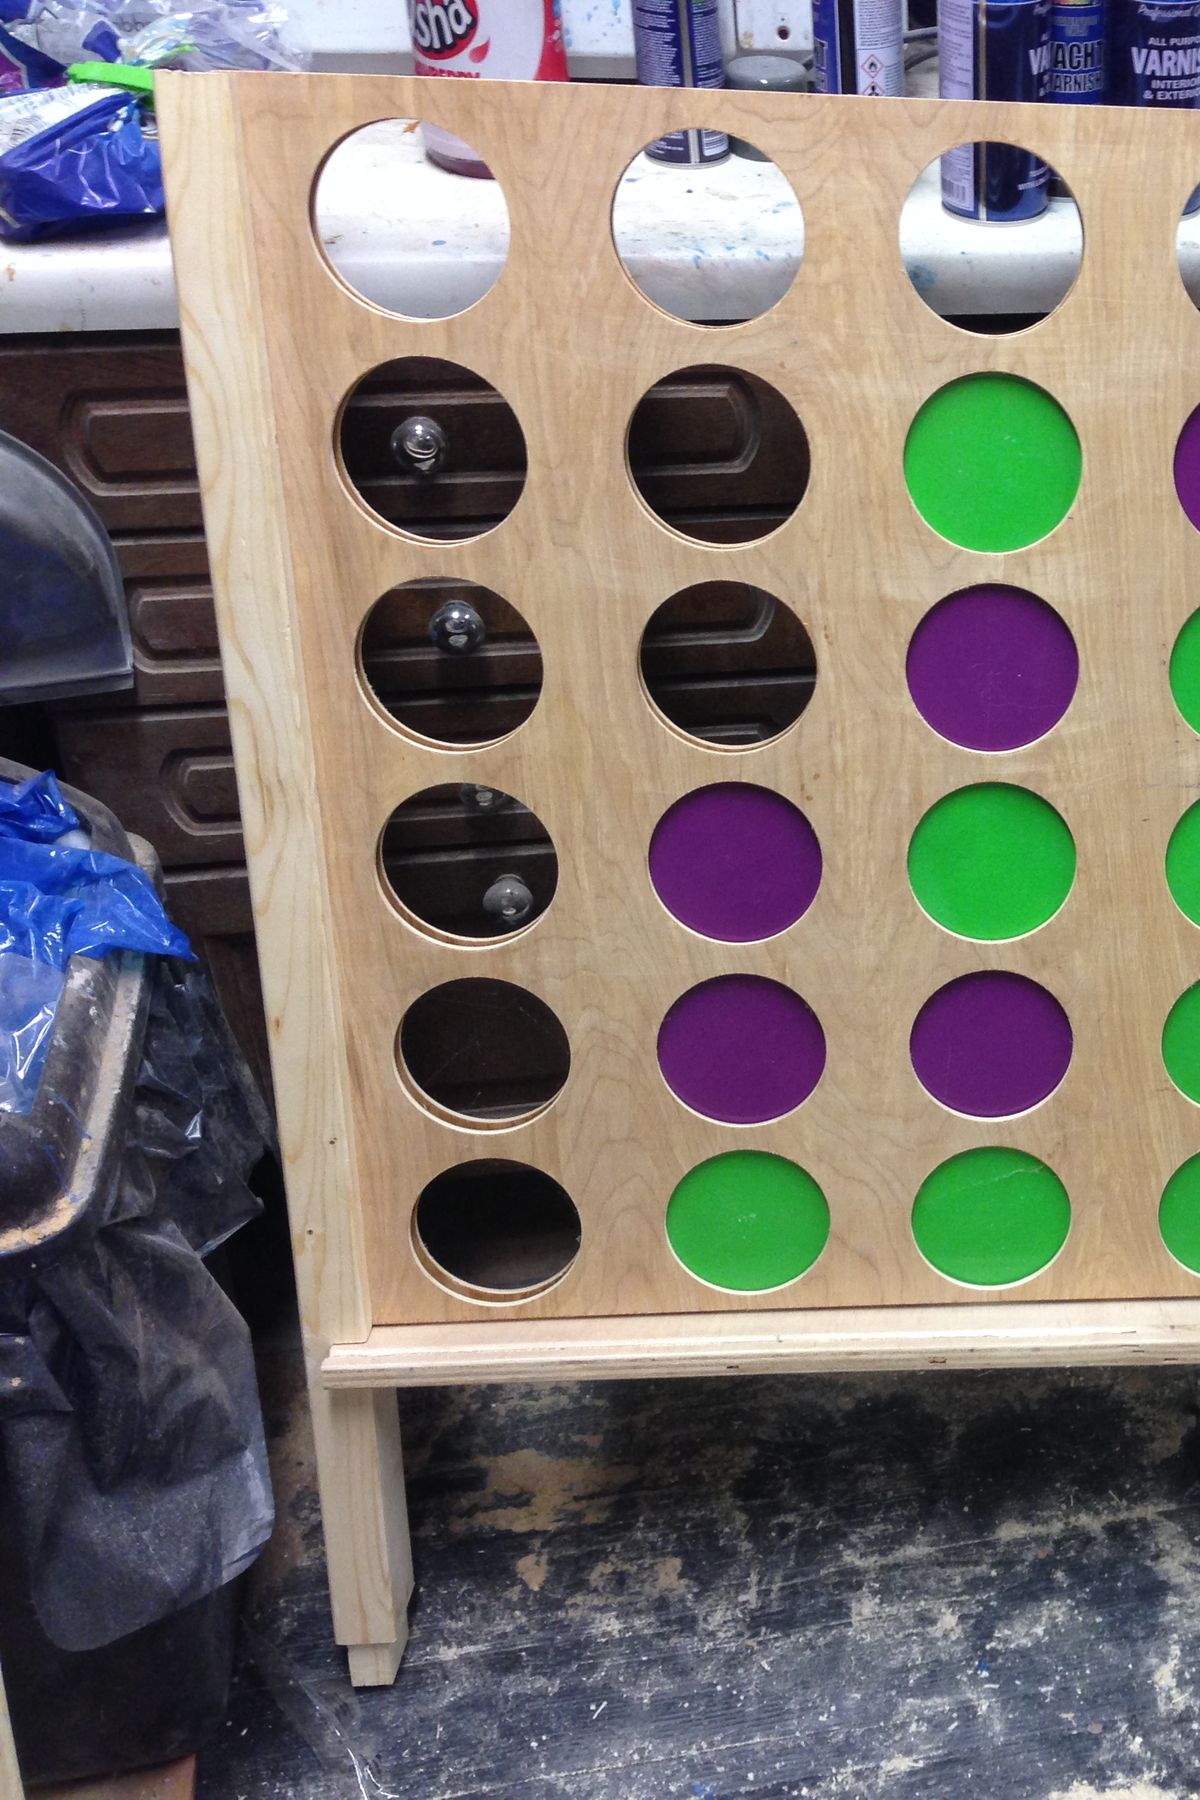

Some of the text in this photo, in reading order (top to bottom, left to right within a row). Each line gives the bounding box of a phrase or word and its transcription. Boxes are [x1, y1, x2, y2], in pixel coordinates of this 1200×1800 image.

[409, 0, 473, 49] sha
[1148, 36, 1167, 46] ALL
[1051, 72, 1104, 93] ARNIS
[1143, 90, 1154, 99] &
